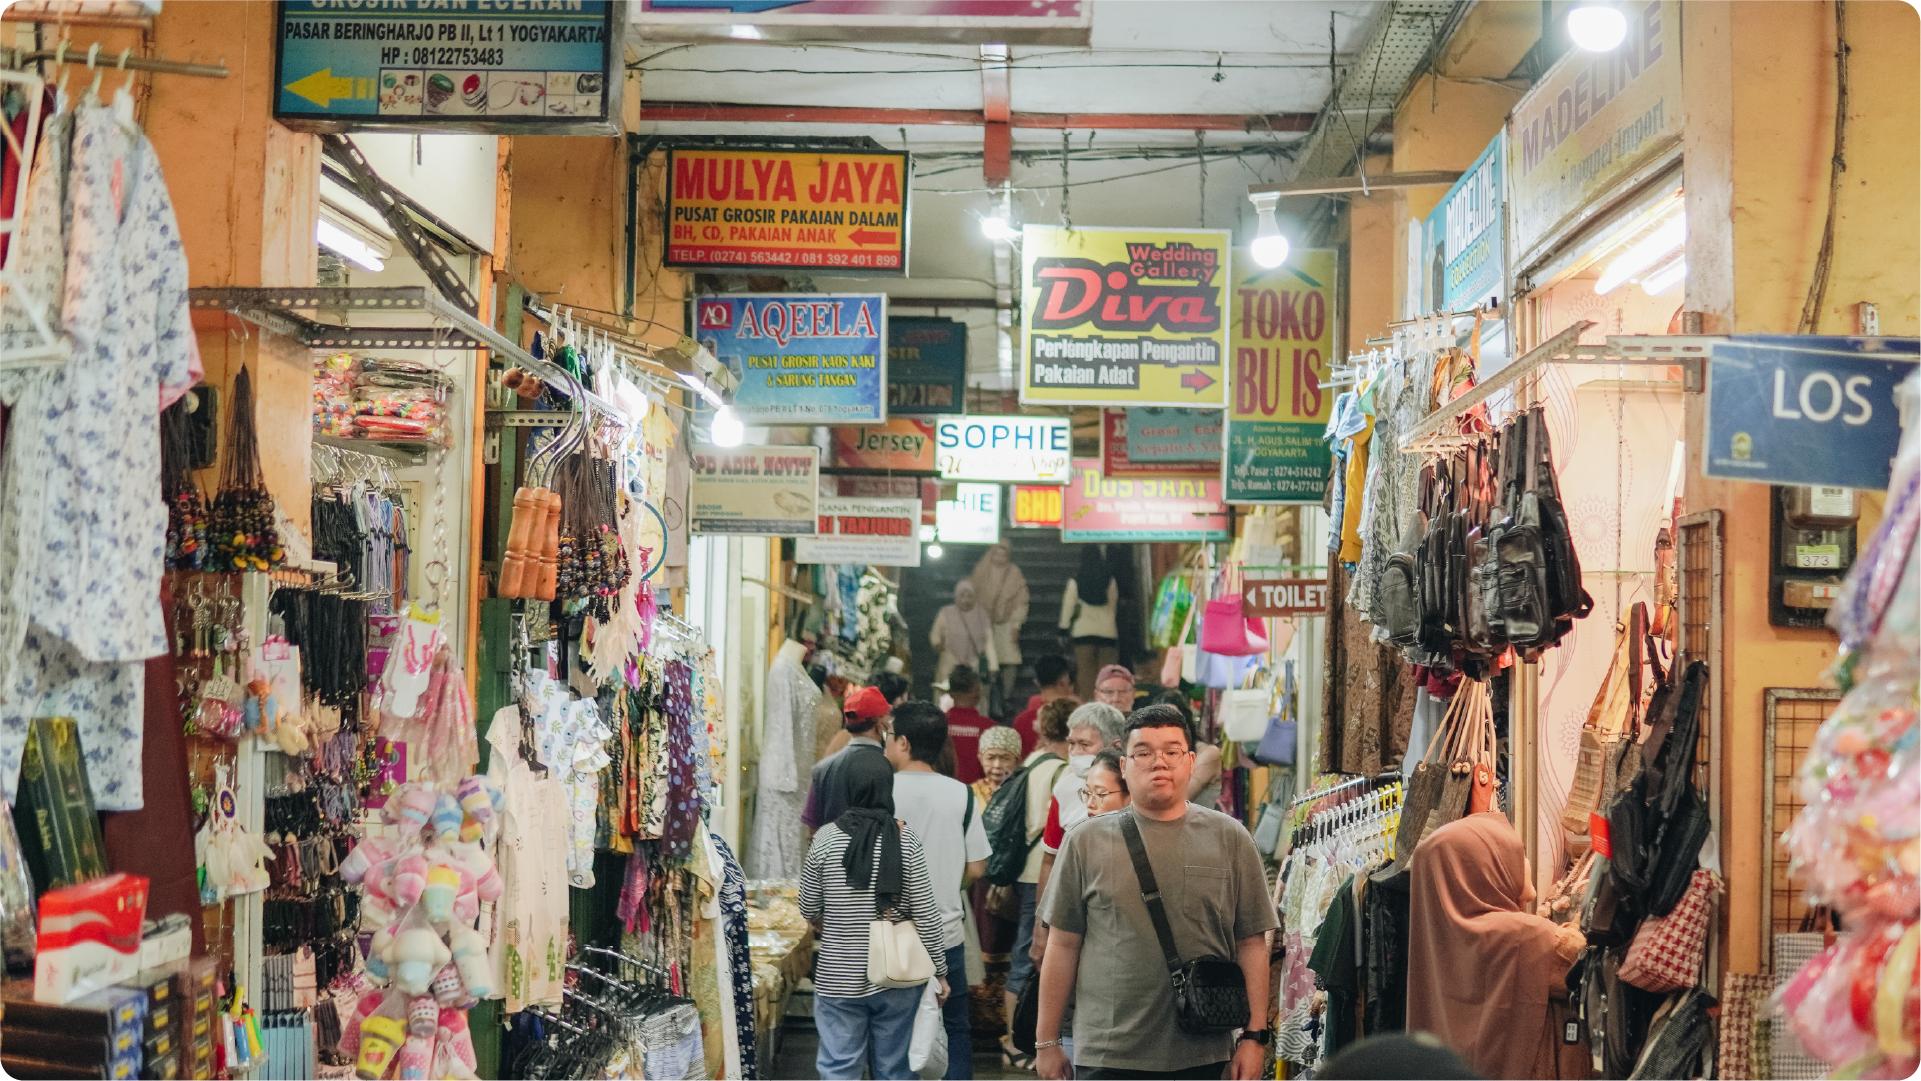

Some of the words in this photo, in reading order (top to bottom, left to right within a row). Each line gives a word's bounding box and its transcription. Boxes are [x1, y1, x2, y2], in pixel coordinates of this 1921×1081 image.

[285, 22, 331, 40] PASAR
[333, 23, 434, 41] BERINGHARJO
[438, 23, 457, 42] PB
[479, 24, 492, 42] Lt
[497, 24, 504, 42] 1
[509, 25, 604, 43] YOGYAKARTA
[381, 47, 400, 65] HP
[412, 47, 504, 66] 08122753483
[675, 158, 797, 202] MULYA
[808, 161, 900, 205] JAYA
[675, 207, 719, 222] PUSAT
[723, 208, 776, 223] GROSIR
[781, 210, 844, 225] PAKAIAN
[849, 211, 899, 227] DALAM
[1446, 150, 1496, 269] MADELINE
[674, 225, 697, 242] BH,
[702, 226, 725, 243] CD,
[730, 226, 792, 242] PAKAIAN
[796, 228, 837, 243] ANAK
[673, 250, 706, 262] TELP.
[710, 251, 746, 263] (0274)
[751, 252, 792, 263] 563442
[802, 253, 823, 264] 081
[827, 254, 848, 265] 392
[851, 255, 872, 266] 401
[876, 255, 898, 266] 899
[1130, 246, 1215, 266] Wedding
[1451, 232, 1491, 291] COLLECTION
[1130, 262, 1215, 282] Gallery
[1037, 267, 1214, 323] Diva
[735, 301, 878, 348] AQEELA
[1237, 288, 1325, 342] TOKO
[1034, 338, 1139, 362] Perlengkapan
[1142, 340, 1216, 363] Pengantin
[748, 355, 778, 368] PUSAT
[781, 355, 819, 368] GROSIR
[822, 355, 849, 368] KAOS
[851, 355, 875, 368] KAKI
[776, 374, 816, 387] SARUNG
[818, 373, 857, 387] TANGAN
[1034, 363, 1095, 384] Pakaian
[1098, 365, 1135, 385] Adat
[1236, 347, 1280, 417] BU
[1291, 348, 1322, 418] IS
[1772, 368, 1874, 425] LOS
[834, 405, 874, 415] Yogyakarta
[856, 427, 926, 460] Jersey
[939, 423, 1068, 451] SOPHIE
[1259, 436, 1283, 446] AGUS
[1285, 437, 1312, 447] SALIM
[1251, 447, 1308, 457] OGYAKARTA
[852, 505, 911, 514] PENGANTIN
[1016, 489, 1062, 522] BHD
[838, 516, 911, 536] TANJUNG
[1802, 555, 1830, 567] 373
[1261, 584, 1327, 609] TOILET
